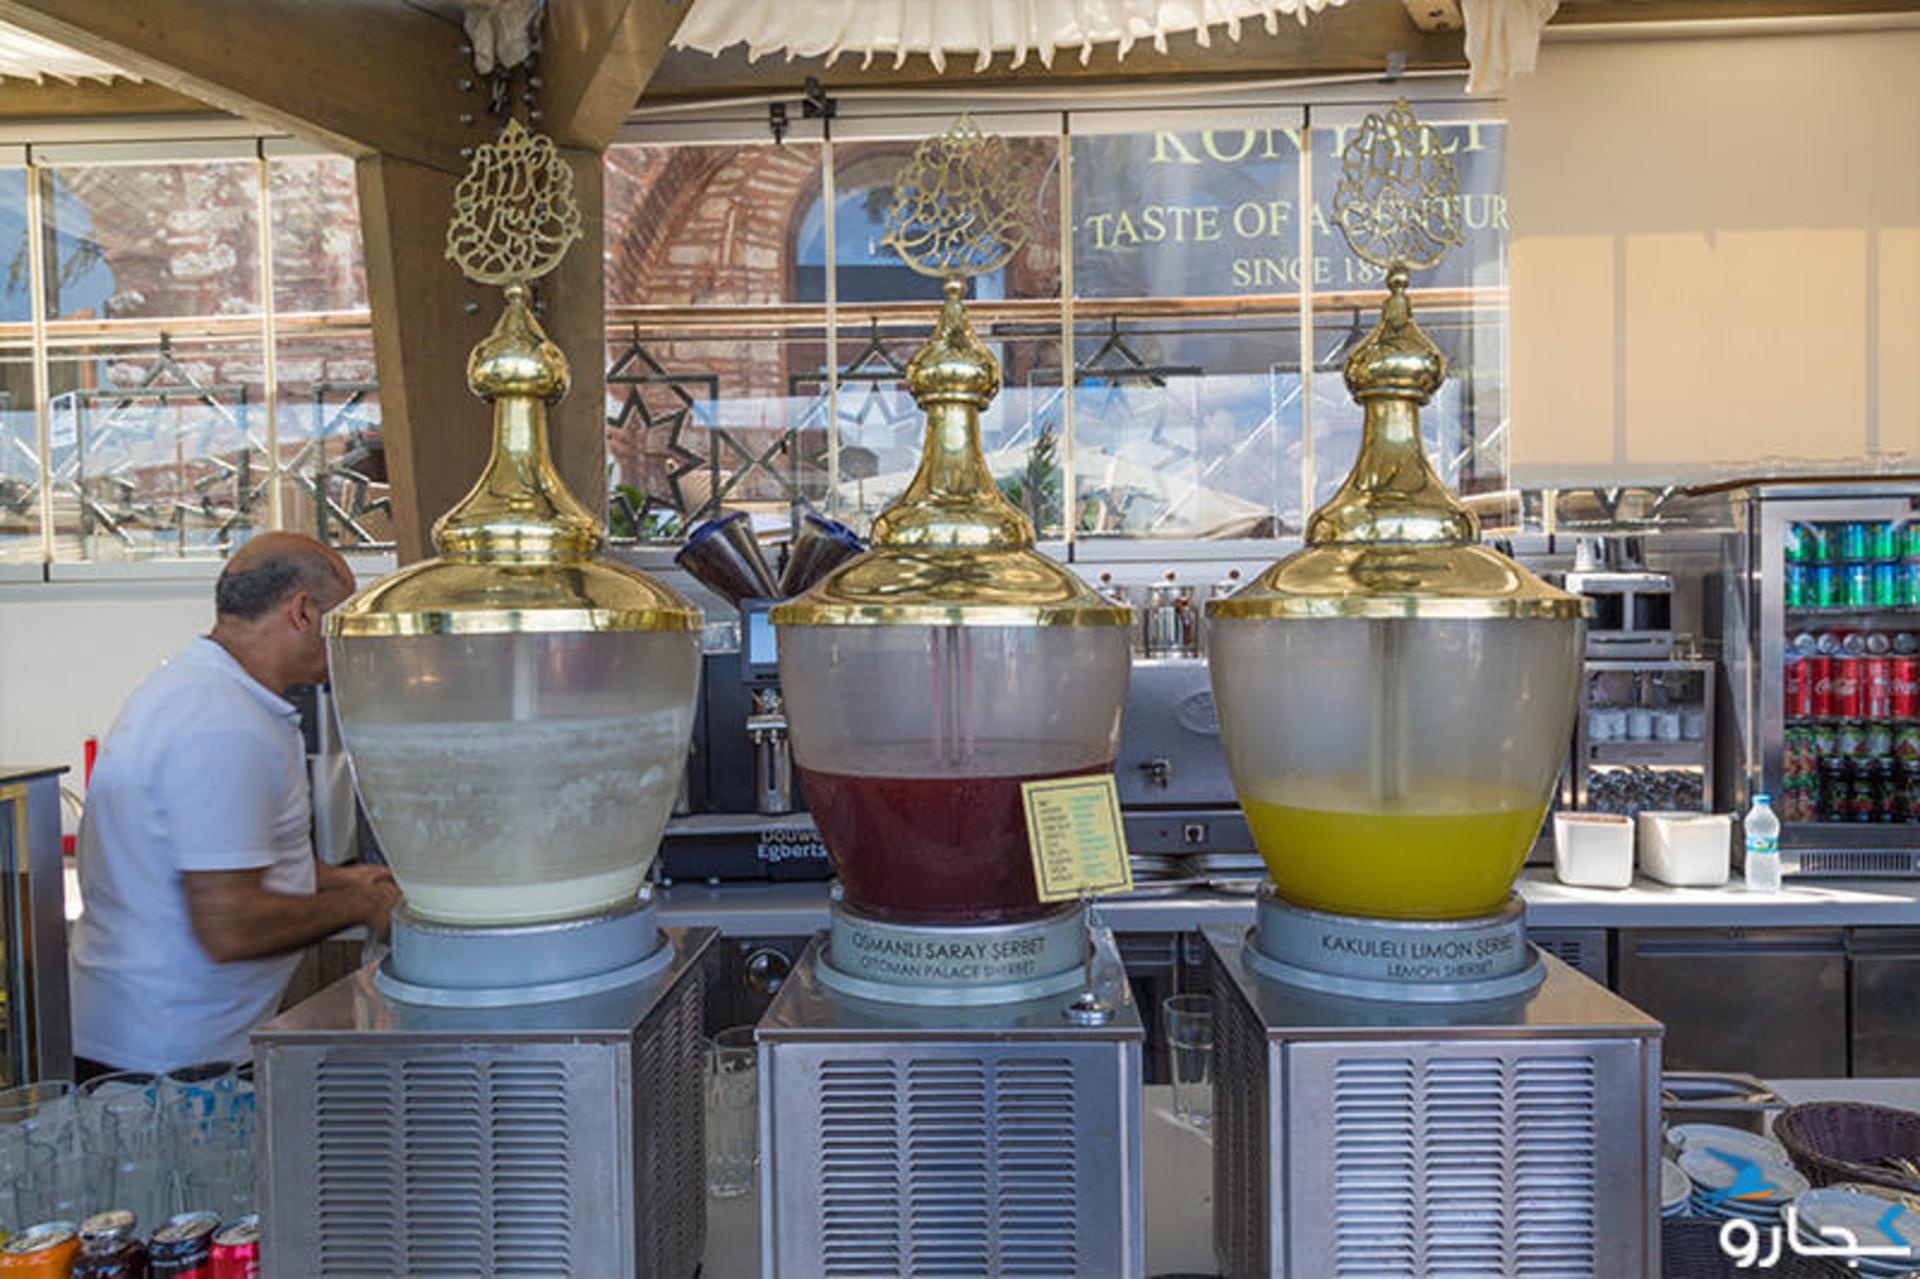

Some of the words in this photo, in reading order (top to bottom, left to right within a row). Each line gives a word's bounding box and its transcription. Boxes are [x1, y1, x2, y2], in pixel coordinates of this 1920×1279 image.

[1086, 205, 1223, 250] TASTE
[1232, 201, 1293, 238] OF
[1341, 194, 1510, 236] CENTUR
[1232, 256, 1333, 287] SINCE
[757, 844, 828, 862] Egberts
[852, 932, 921, 958] OSMANLI
[925, 942, 987, 960] SARAY
